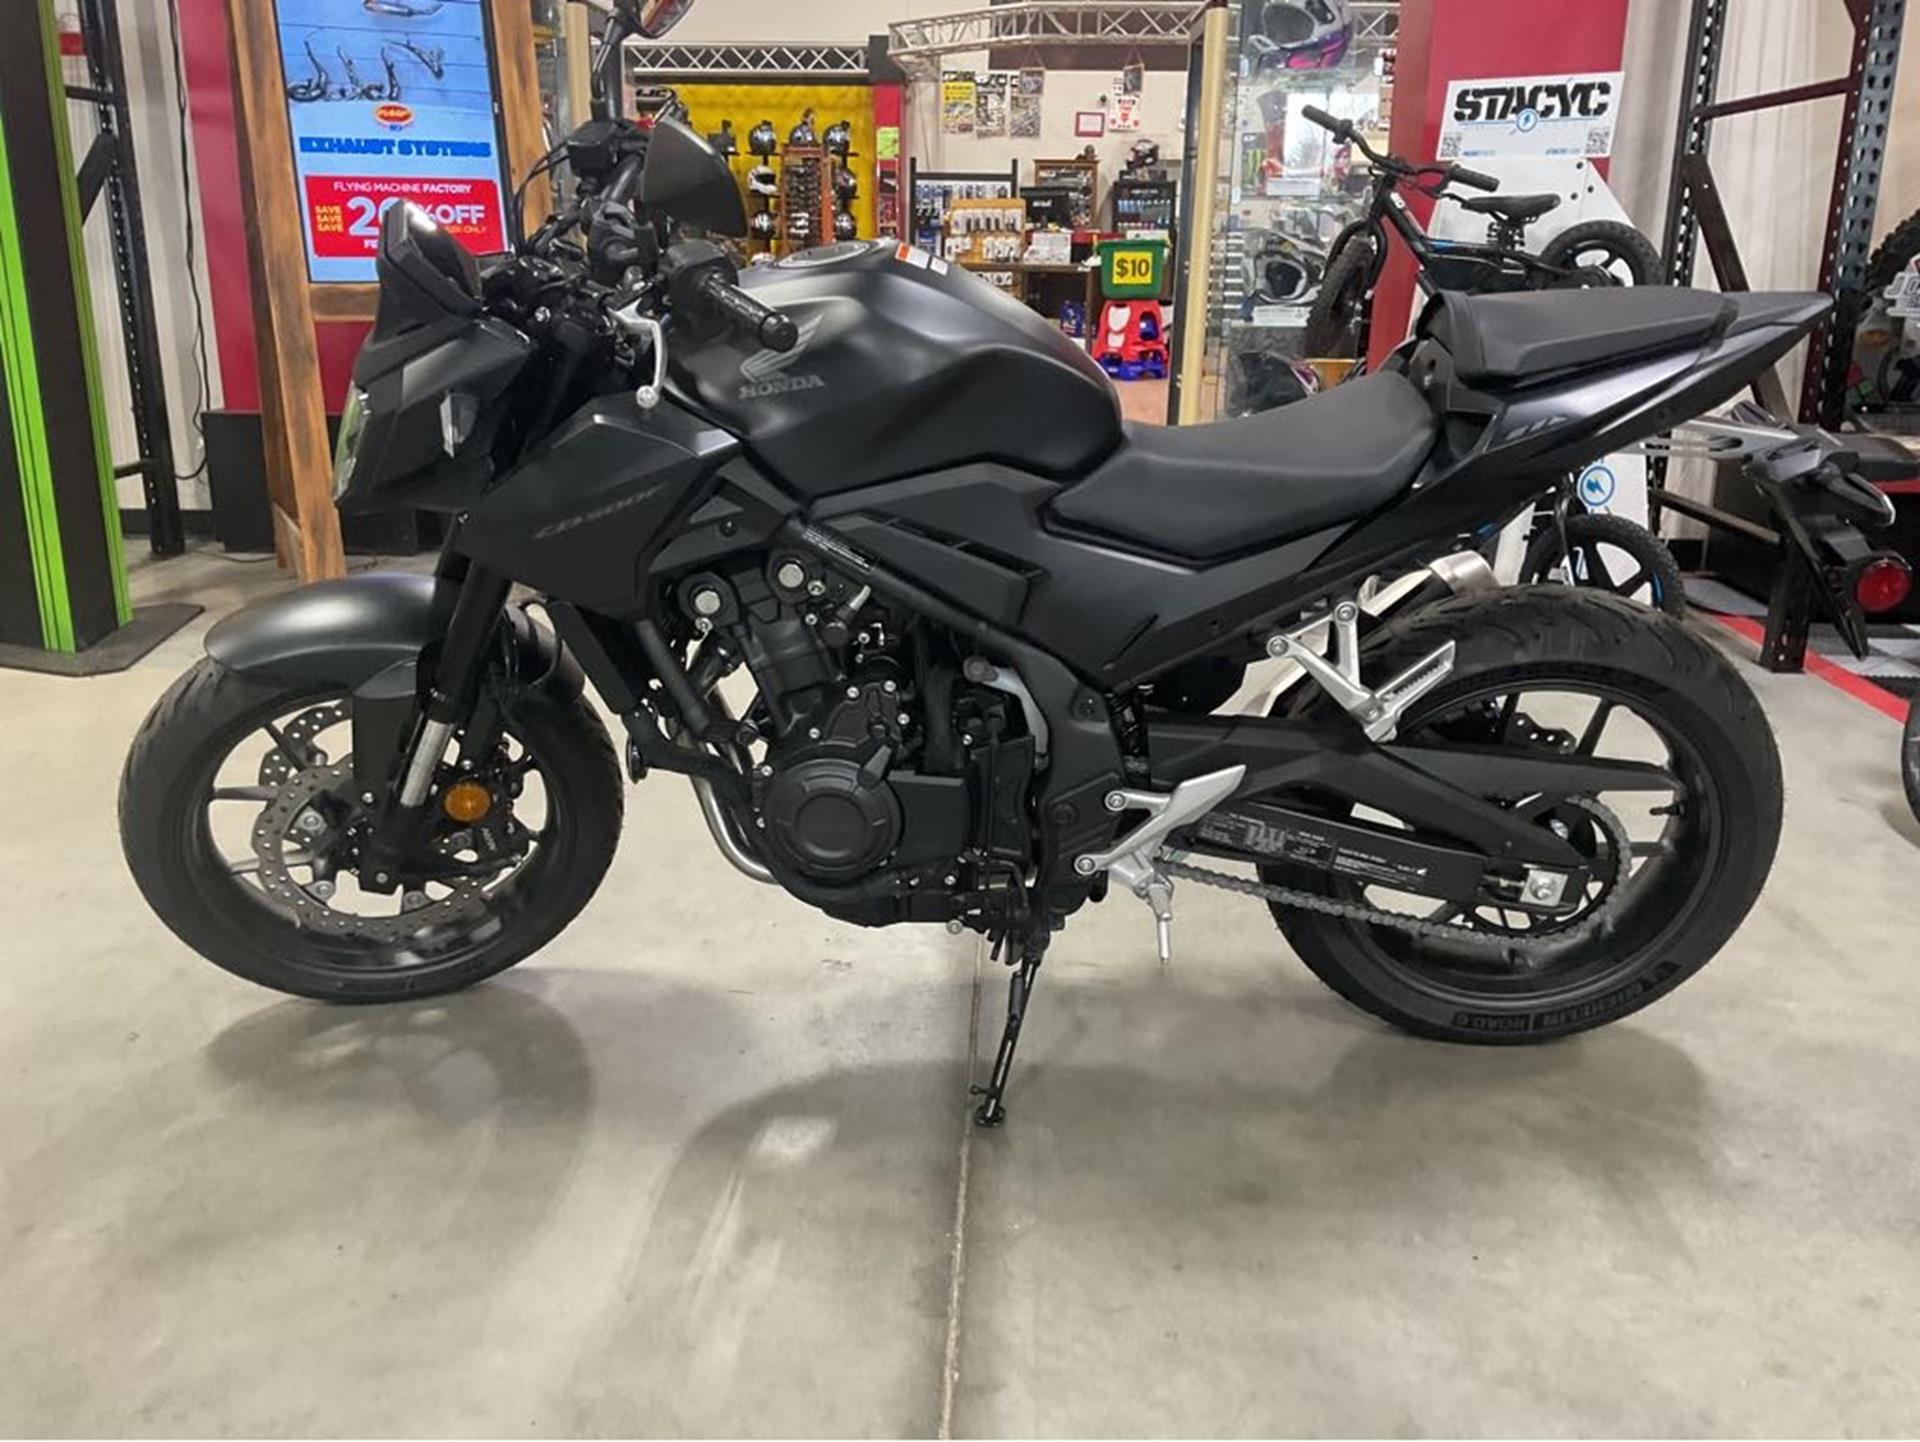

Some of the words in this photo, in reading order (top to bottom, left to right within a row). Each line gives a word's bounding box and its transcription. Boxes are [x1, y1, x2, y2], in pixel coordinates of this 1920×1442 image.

[1454, 82, 1611, 121] STACYC
[300, 137, 395, 155] EXHAUST
[399, 140, 491, 157] SYSTEMS
[334, 181, 372, 192] FLYING
[374, 183, 420, 194] MACHINE
[423, 184, 472, 194] FACTORY
[315, 205, 341, 213] SAVE
[316, 214, 342, 222] SAVE
[318, 223, 343, 231] SAVE
[1115, 258, 1149, 278] $10
[739, 375, 825, 399] HONDA
[1543, 981, 1645, 1027] MICHELIN
